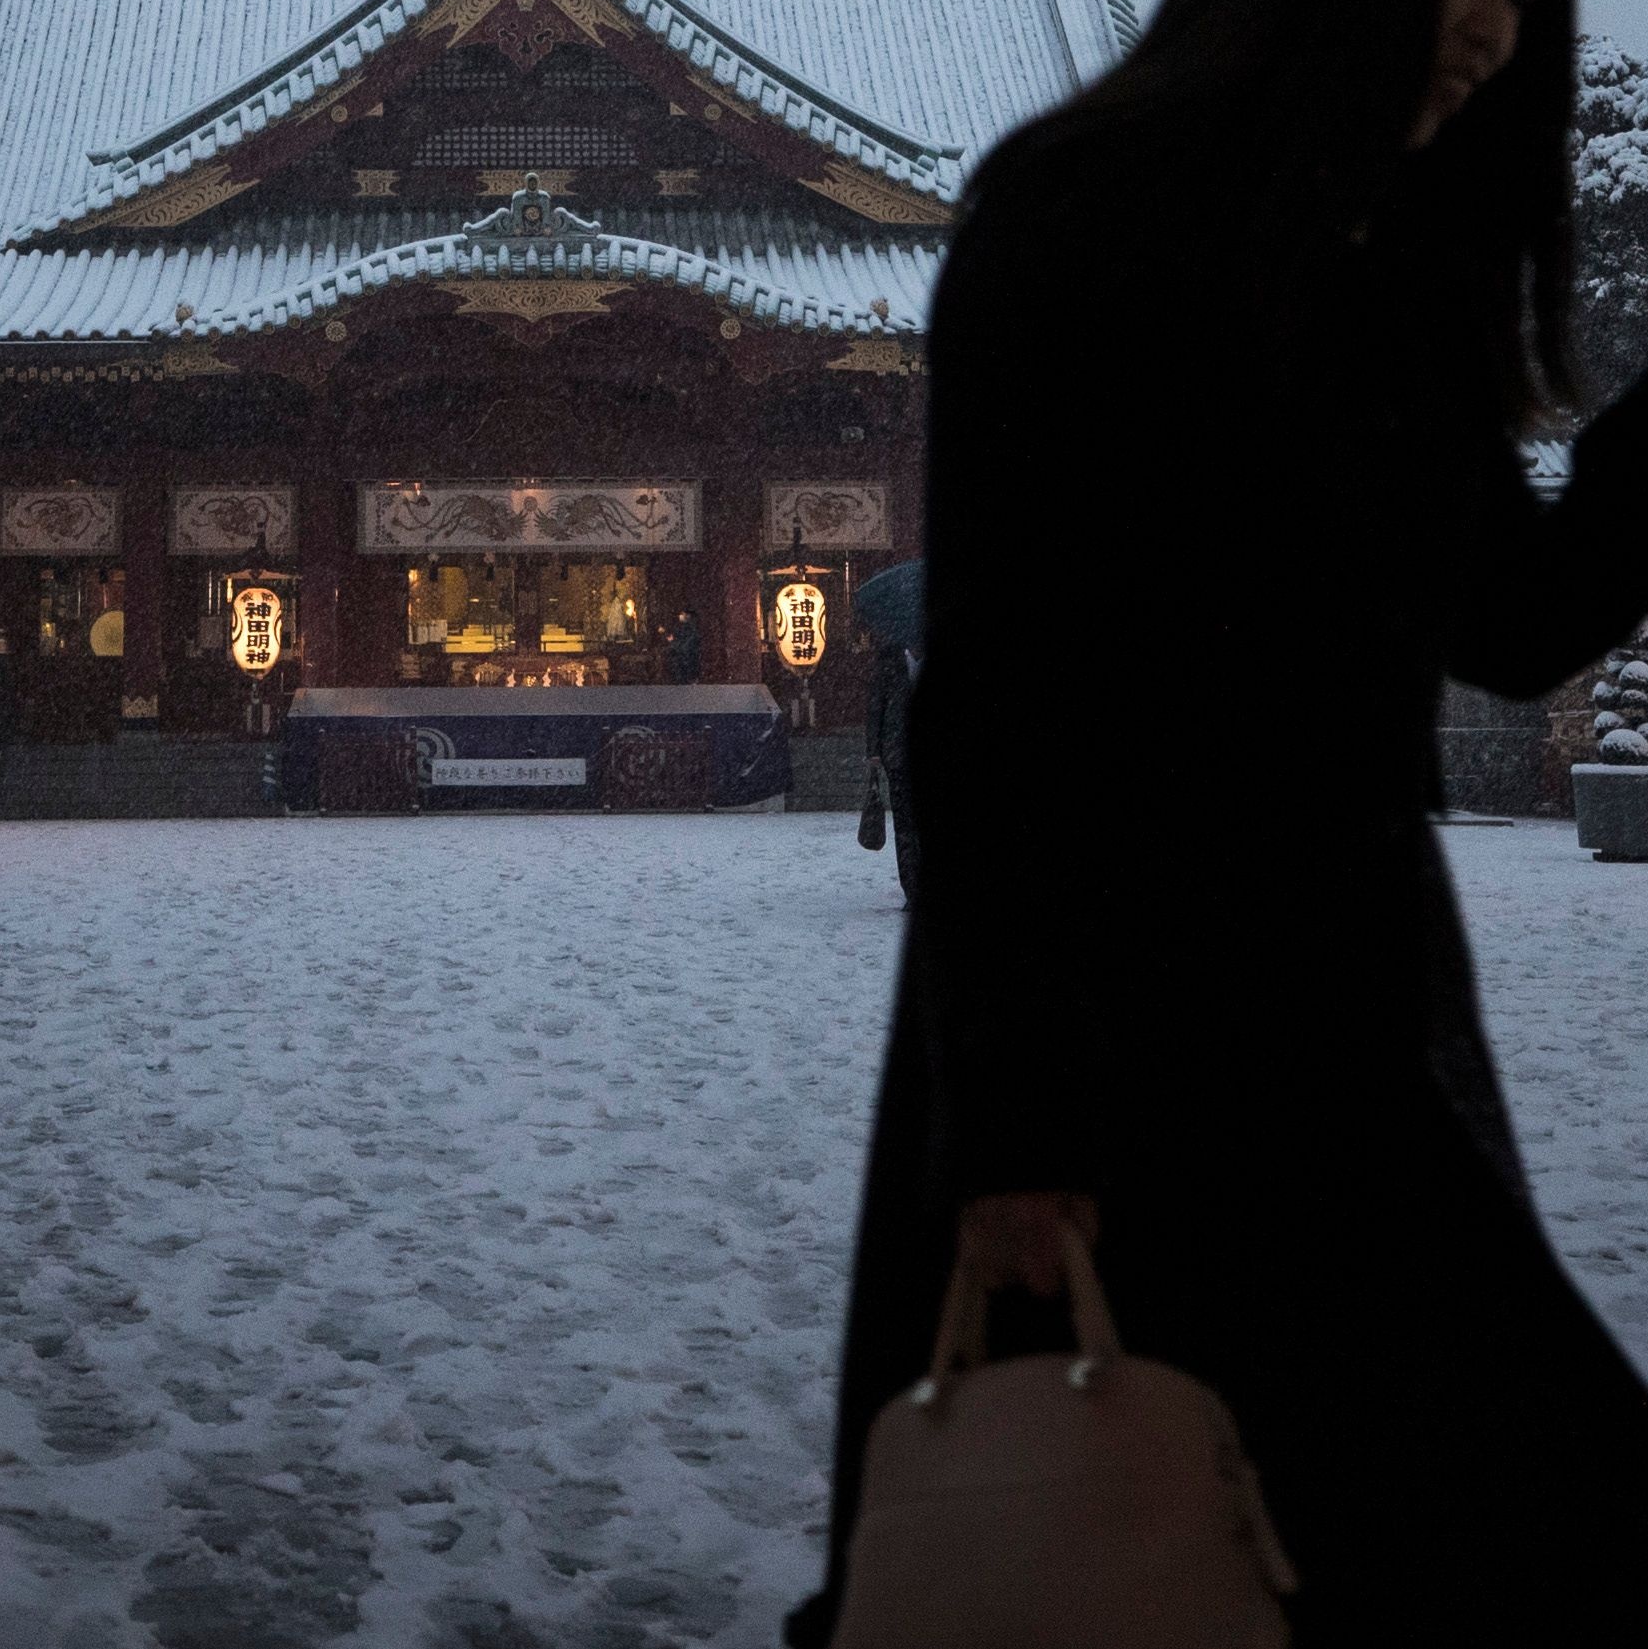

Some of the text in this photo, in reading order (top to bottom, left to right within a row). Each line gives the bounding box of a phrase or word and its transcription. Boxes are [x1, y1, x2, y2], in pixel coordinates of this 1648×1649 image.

[244, 603, 272, 664] 神田明神
[789, 599, 818, 660] 神田明神
